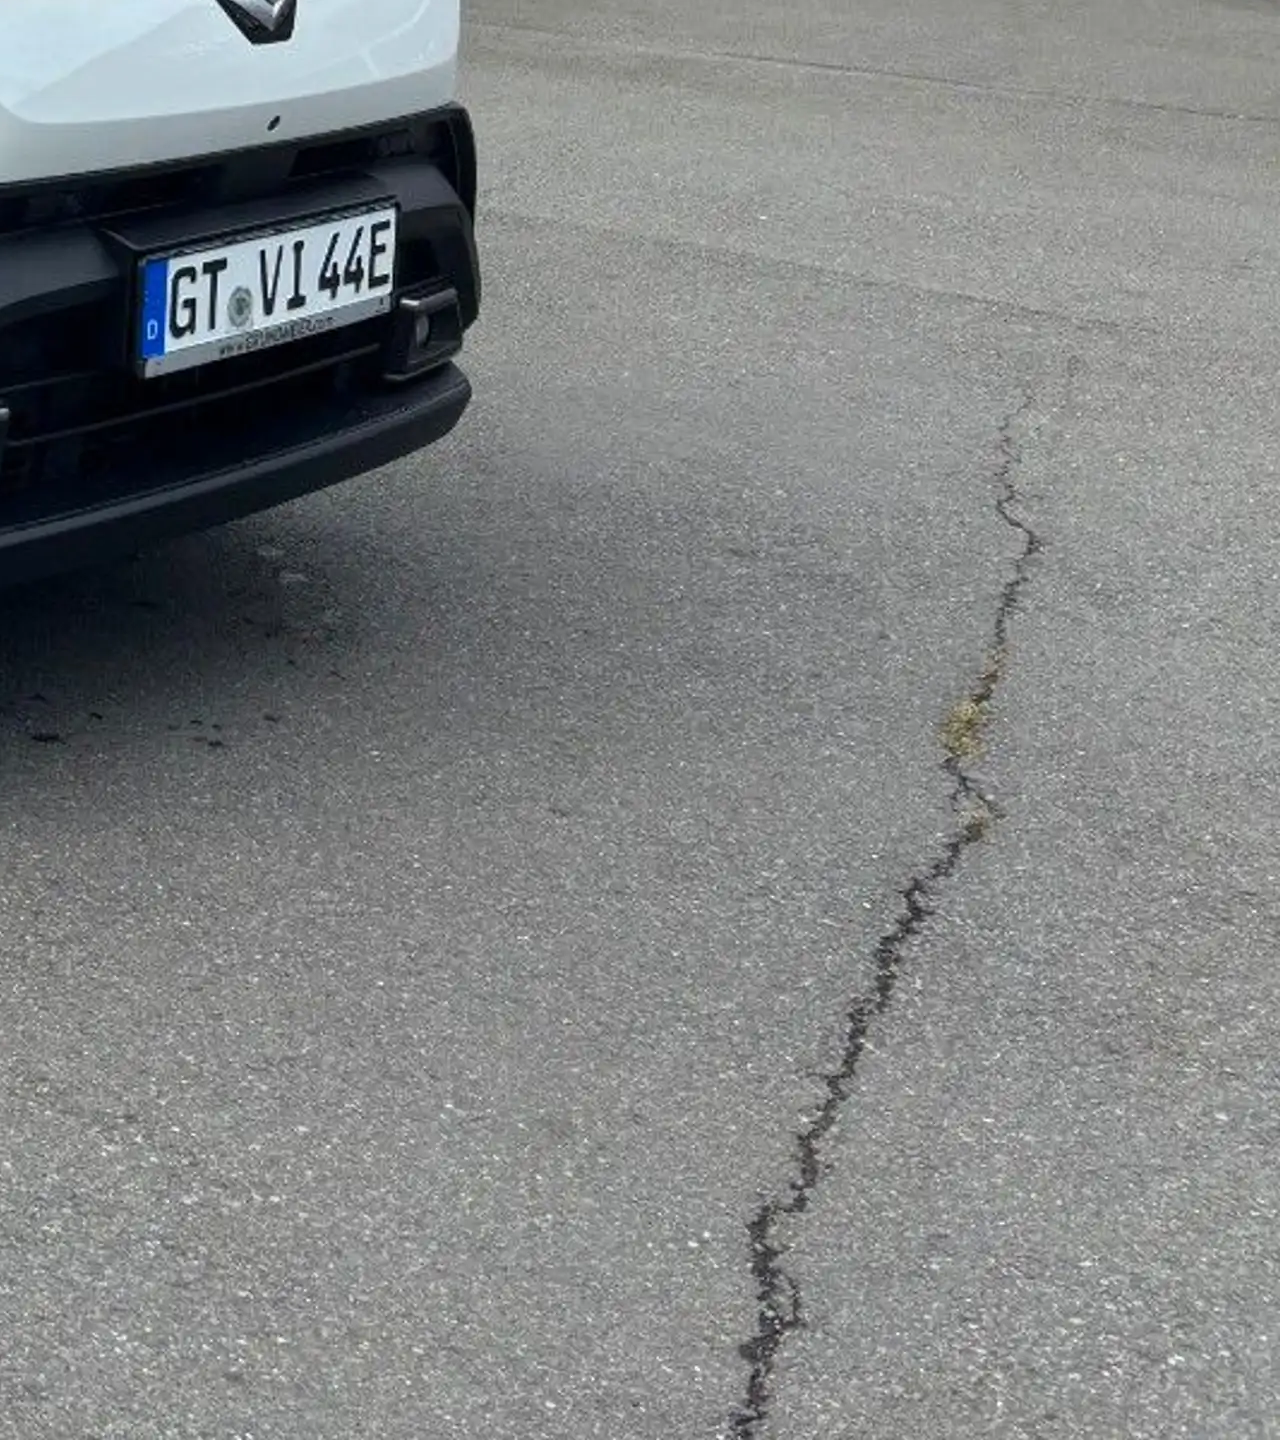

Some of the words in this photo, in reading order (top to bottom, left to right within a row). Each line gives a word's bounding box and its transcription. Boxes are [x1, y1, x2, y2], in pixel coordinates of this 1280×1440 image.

[168, 258, 228, 339] GT
[259, 241, 306, 316] VI
[318, 219, 391, 301] 44E
[147, 319, 158, 340] D
